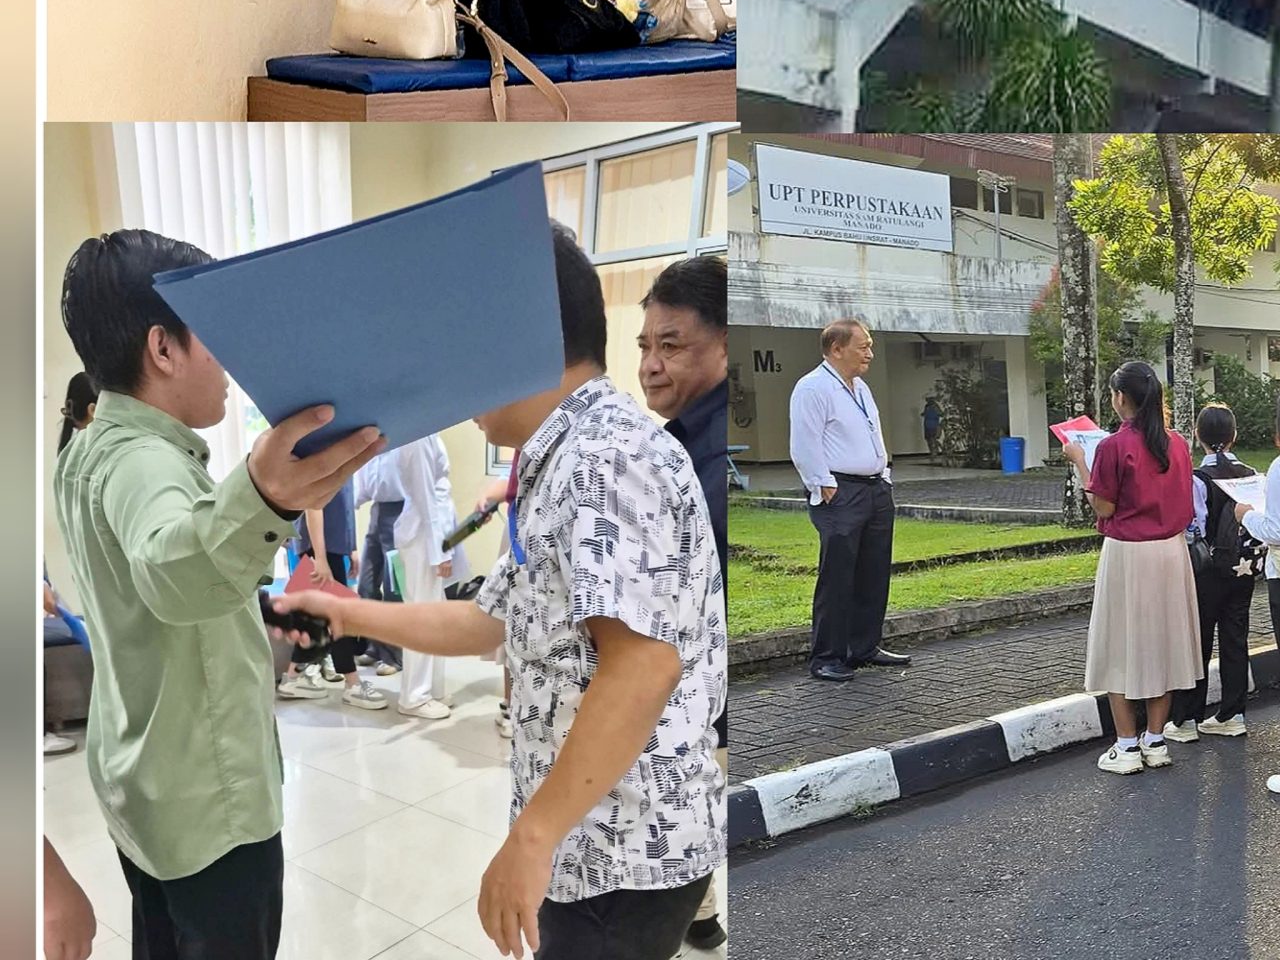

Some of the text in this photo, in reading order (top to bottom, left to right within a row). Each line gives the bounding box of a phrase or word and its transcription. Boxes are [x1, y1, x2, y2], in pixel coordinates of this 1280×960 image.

[769, 183, 943, 221] UPT PERPUSTAKAAN
[794, 205, 854, 220] UNIVERSITAS
[876, 215, 924, 228] RATULANGI
[843, 219, 882, 230] MANADO
[814, 229, 842, 239] KAMPUS
